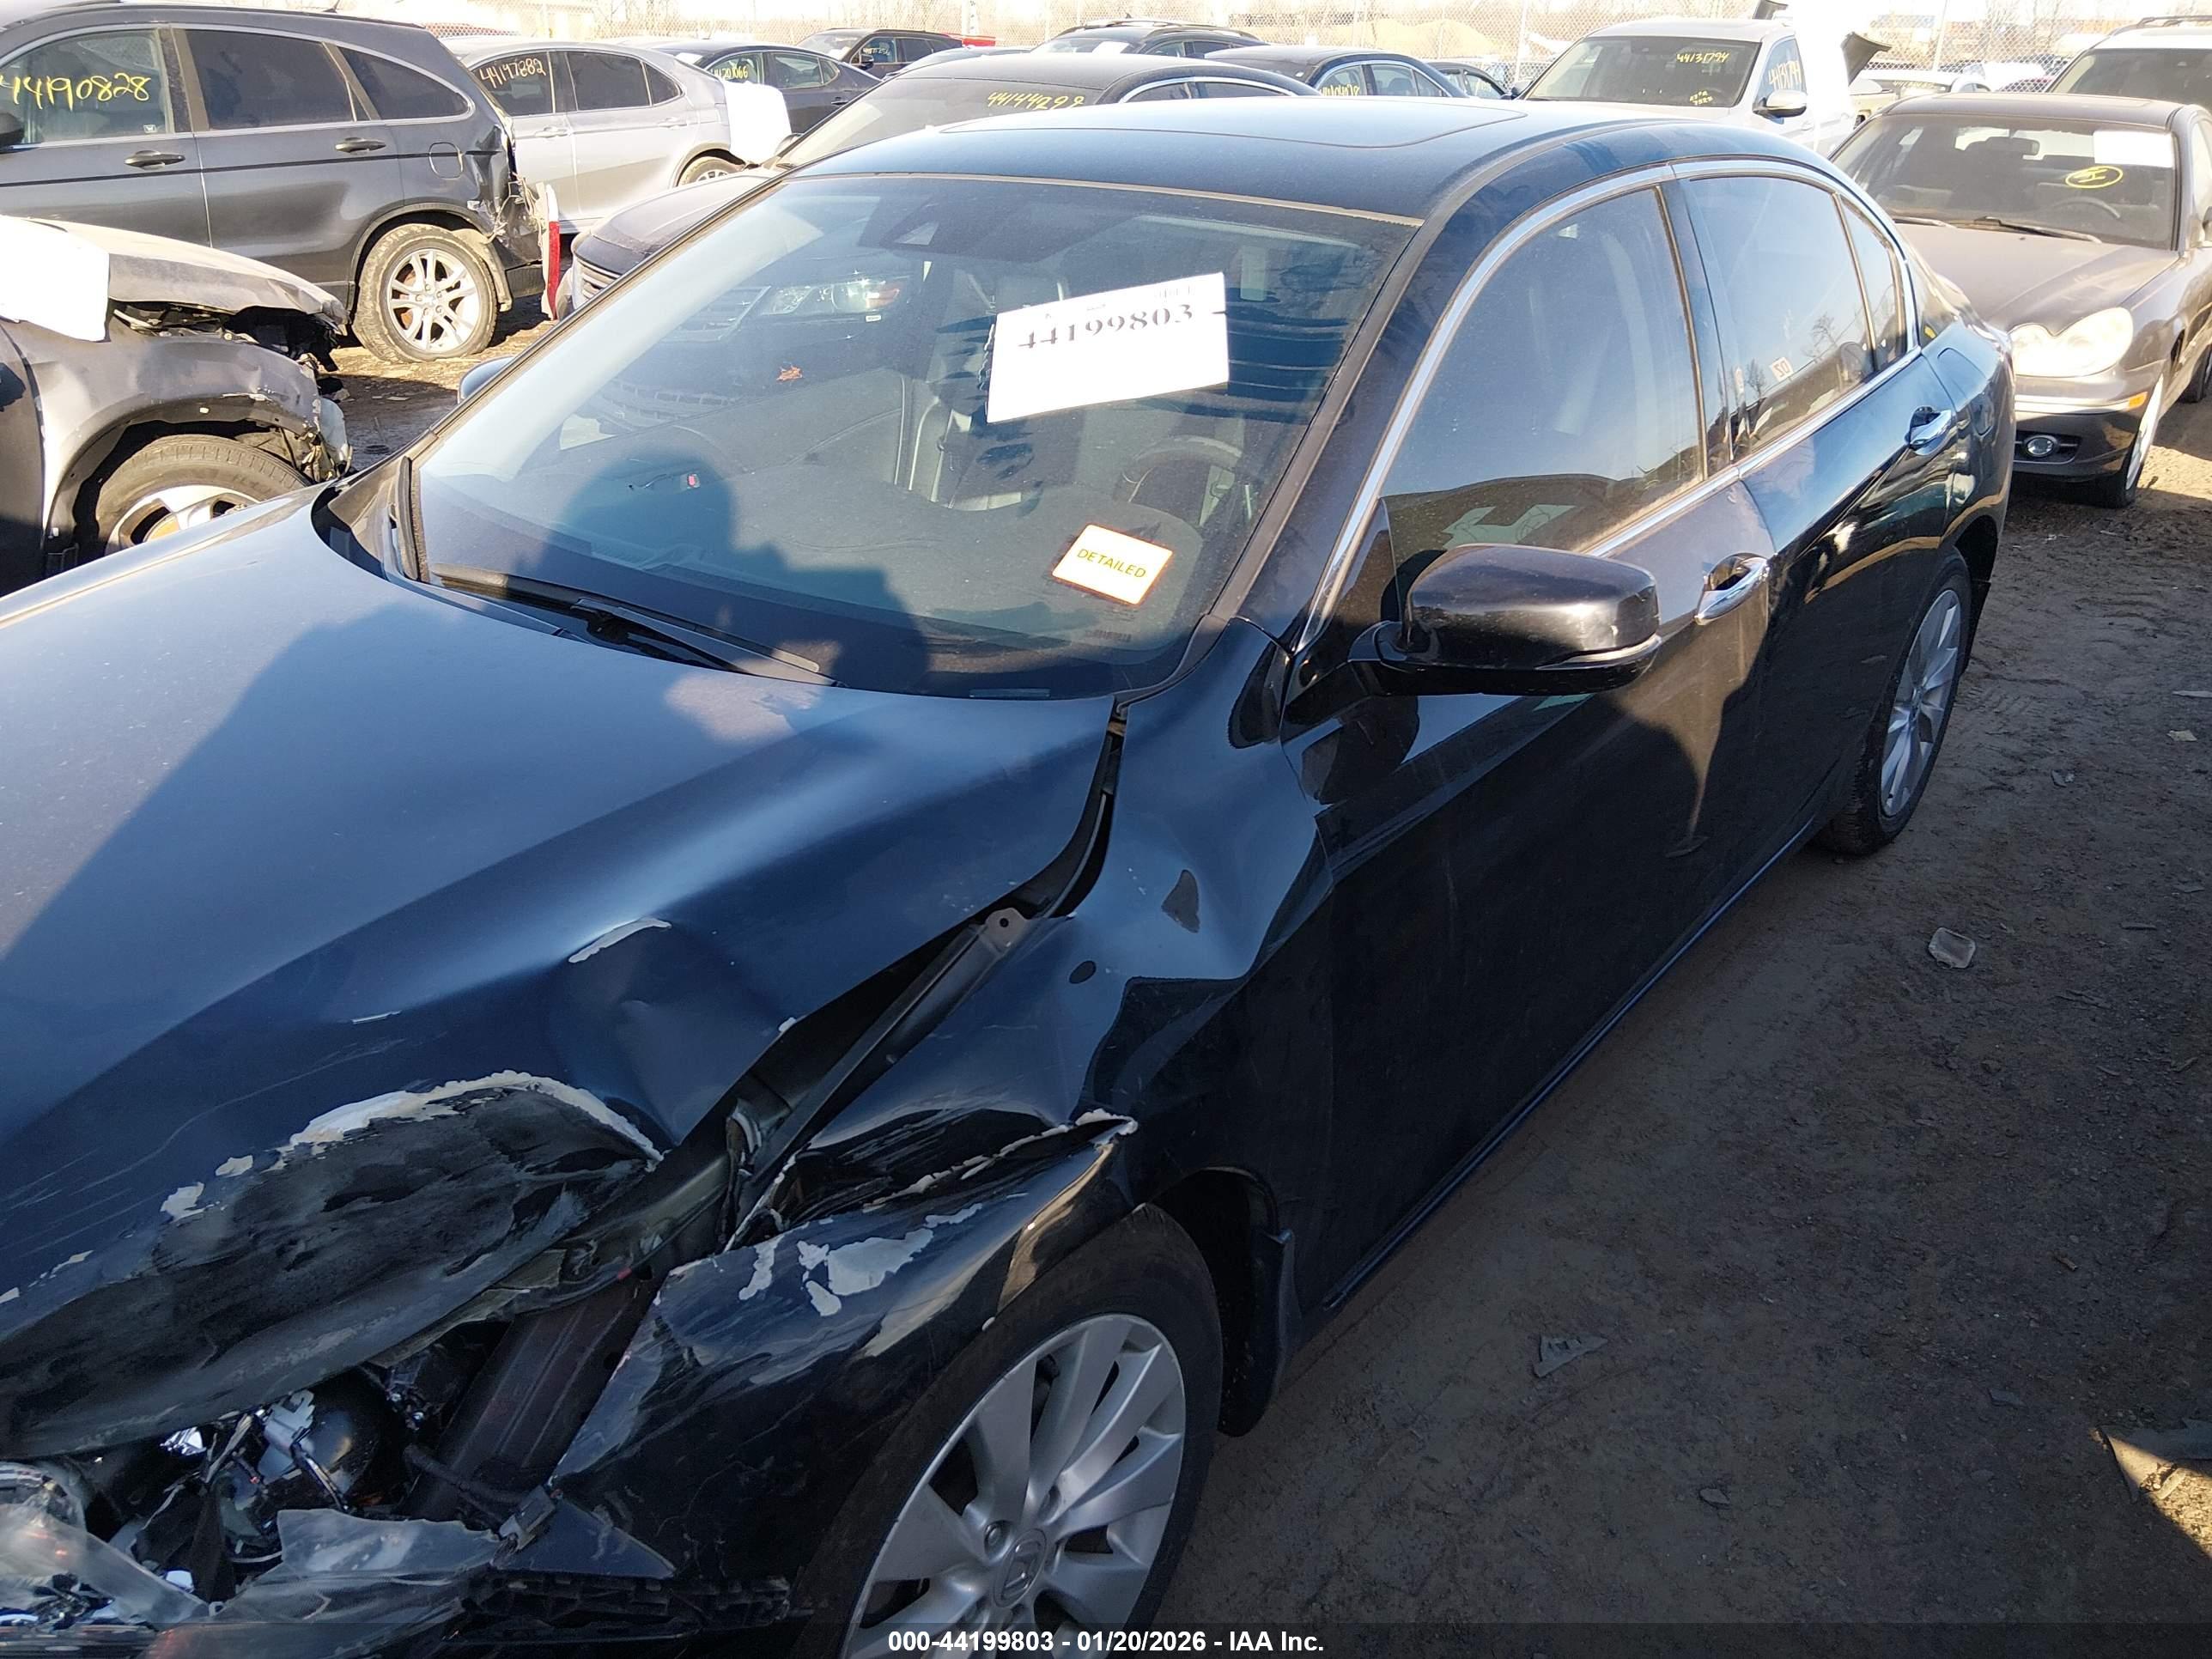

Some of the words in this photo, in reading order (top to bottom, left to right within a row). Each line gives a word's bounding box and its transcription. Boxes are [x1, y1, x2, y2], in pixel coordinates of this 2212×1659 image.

[479, 58, 546, 88] 44197882
[0, 72, 151, 112] 44190828
[1018, 304, 1193, 349] 44199803
[1077, 549, 1146, 578] DETAILED
